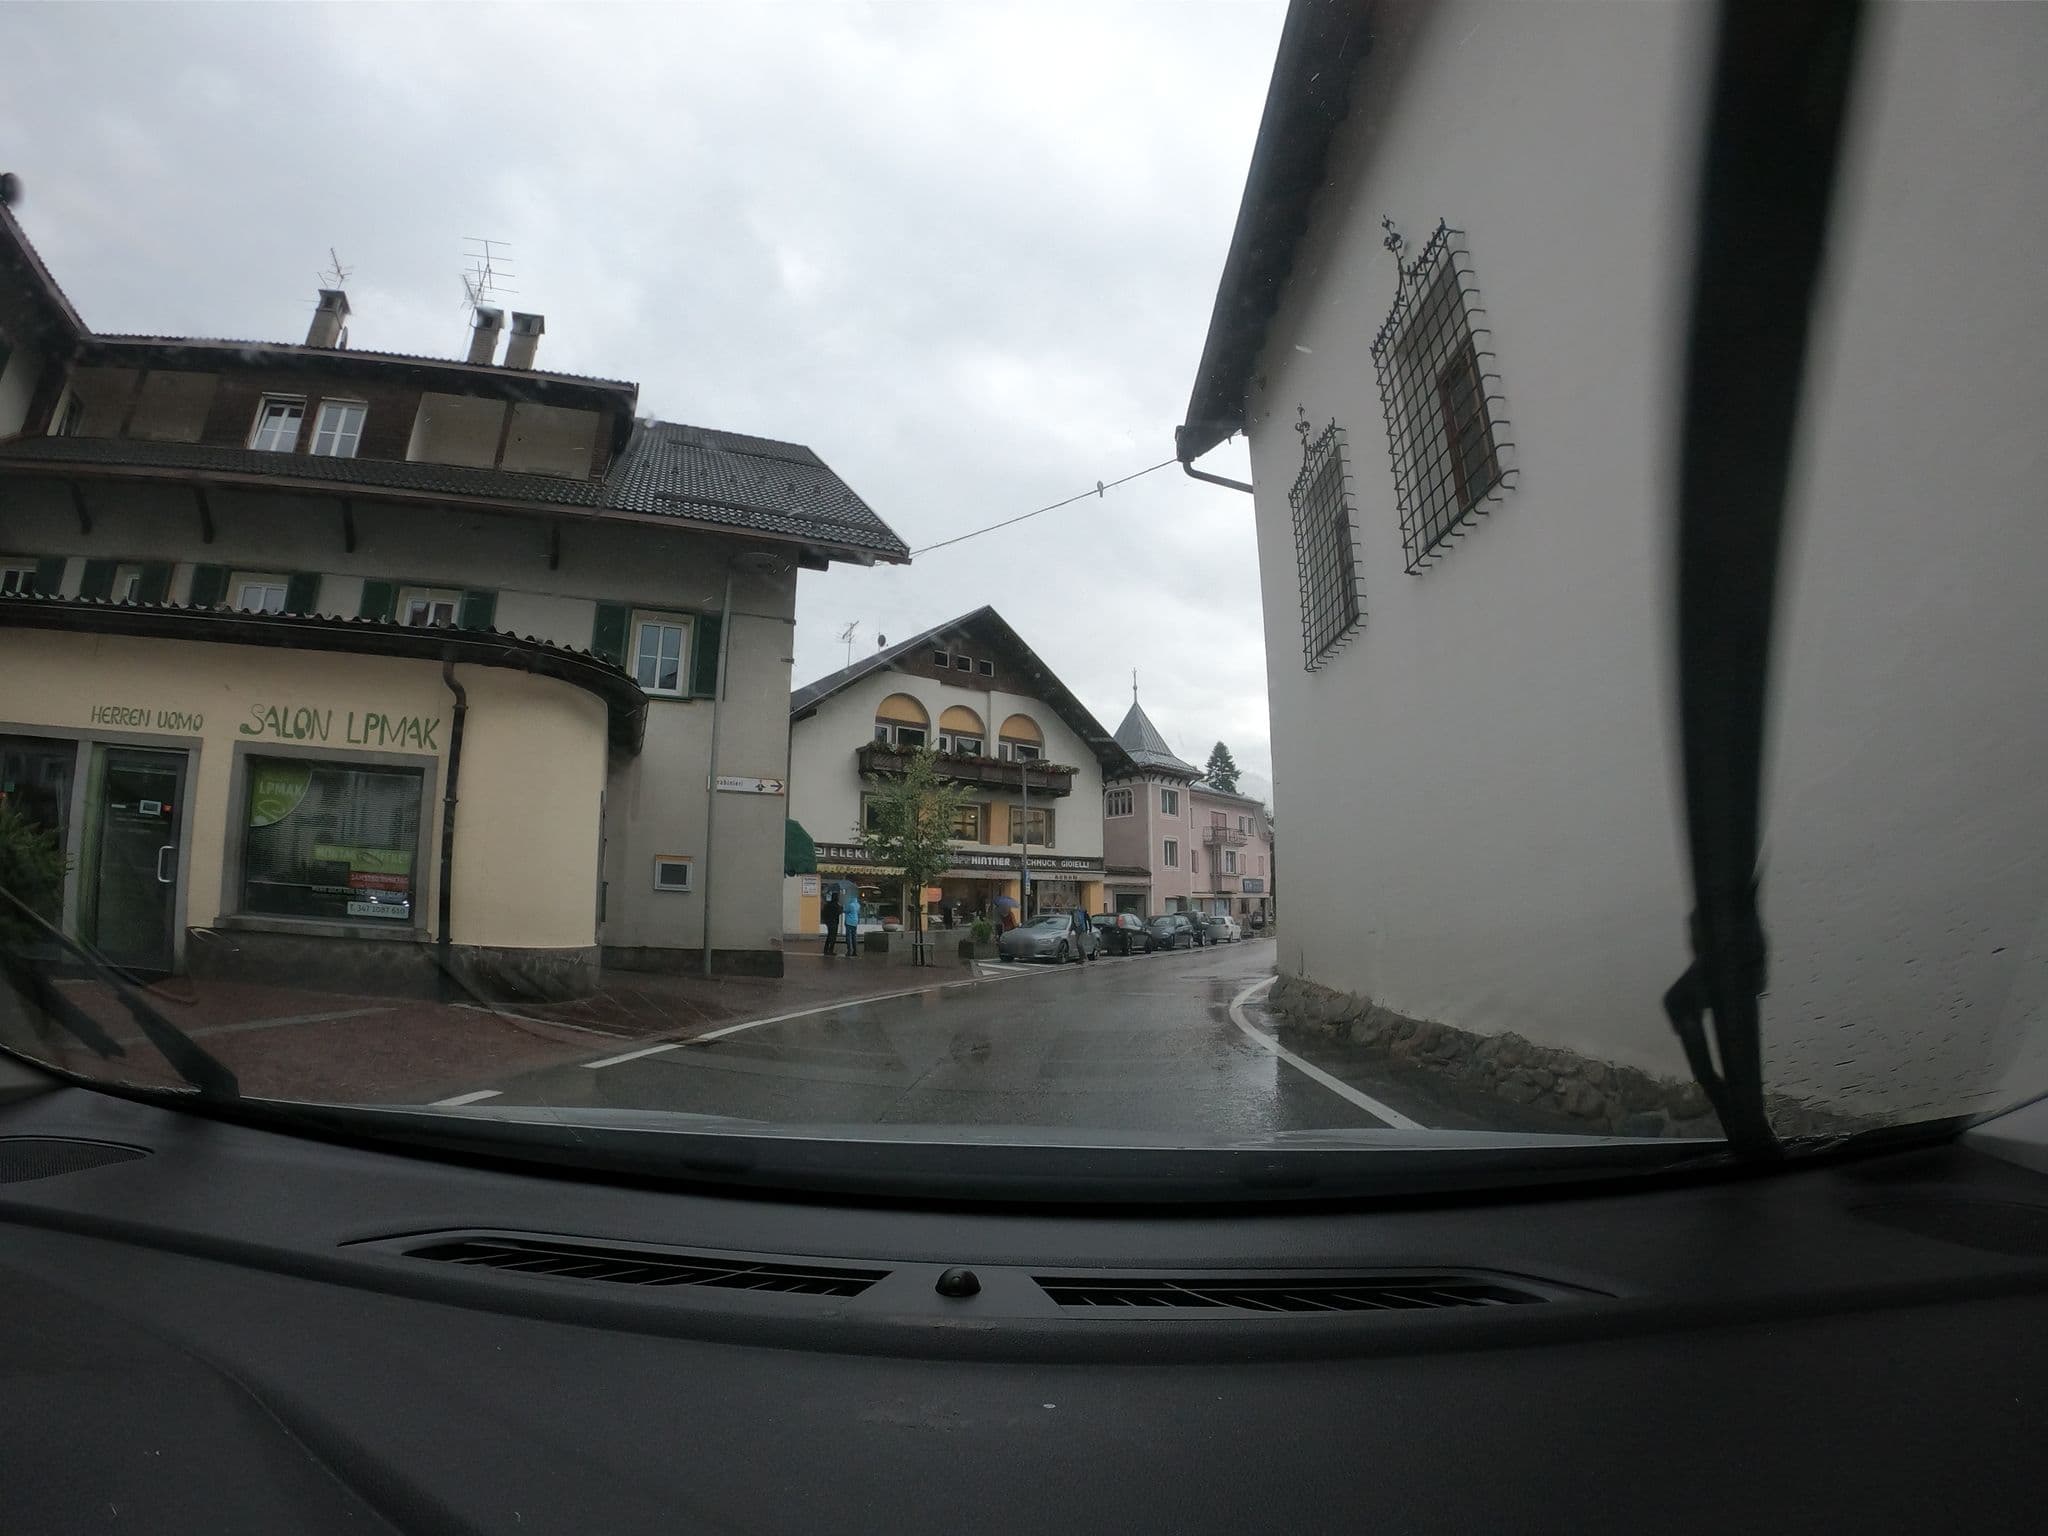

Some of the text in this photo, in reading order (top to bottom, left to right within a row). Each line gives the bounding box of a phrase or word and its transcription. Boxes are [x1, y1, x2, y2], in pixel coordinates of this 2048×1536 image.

[90, 705, 203, 732] HERREN UOMO
[239, 703, 439, 750] SALON LPMAK
[971, 856, 1010, 867] HINTNER
